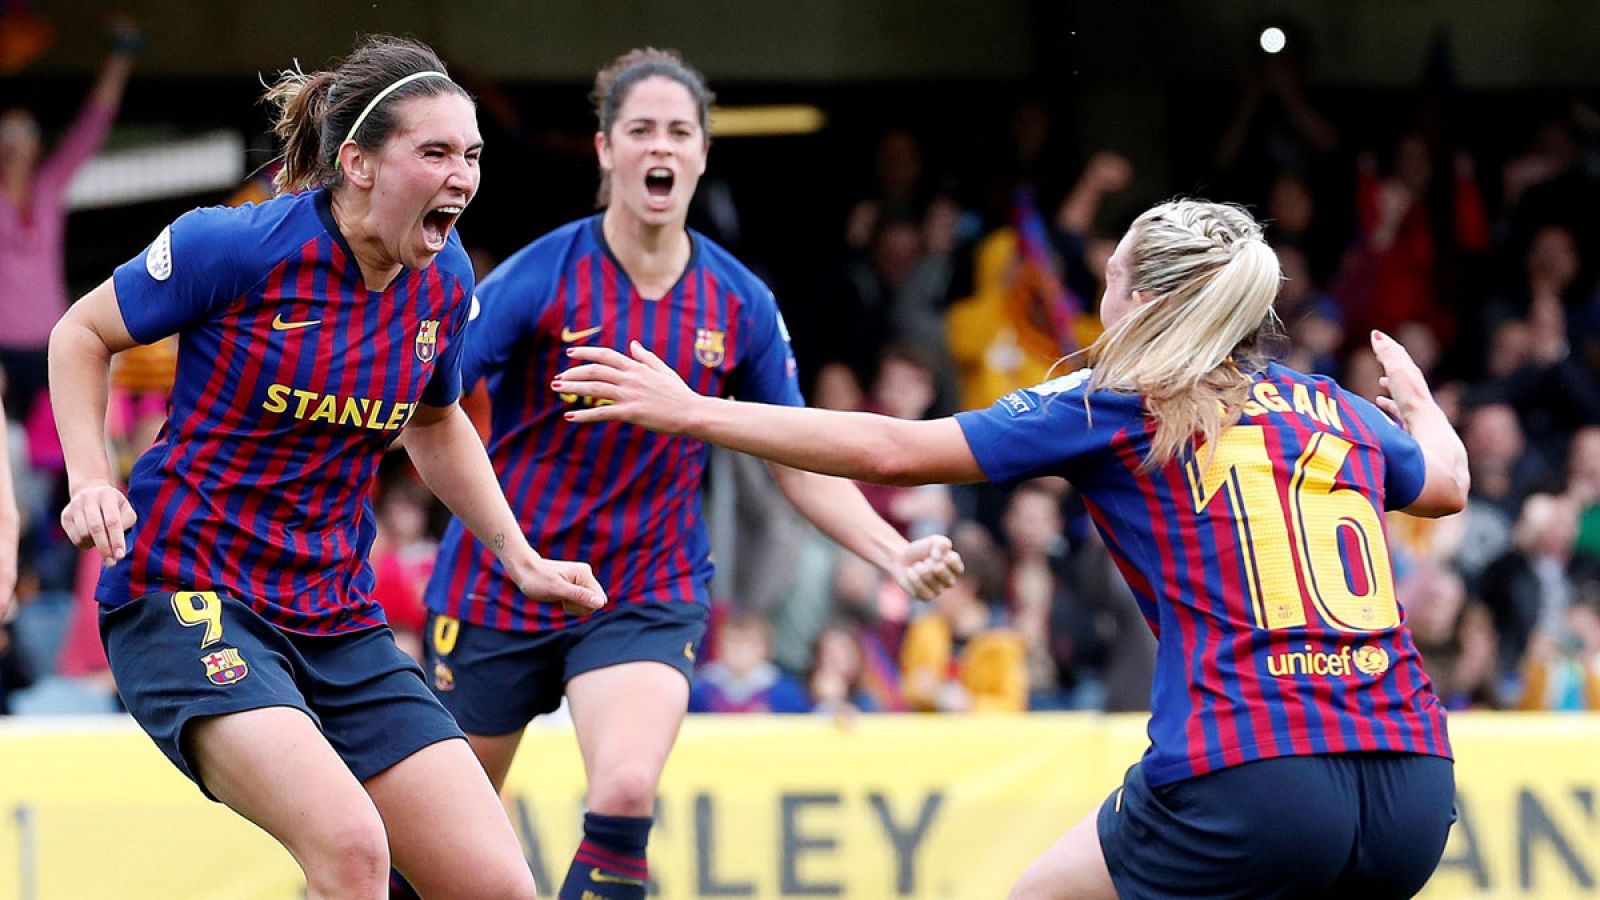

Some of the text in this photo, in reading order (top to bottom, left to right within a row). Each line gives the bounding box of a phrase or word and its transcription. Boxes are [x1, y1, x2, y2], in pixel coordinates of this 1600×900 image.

[1186, 425, 1401, 633] 16
[171, 591, 223, 650] 9
[1266, 645, 1352, 676] unicef
